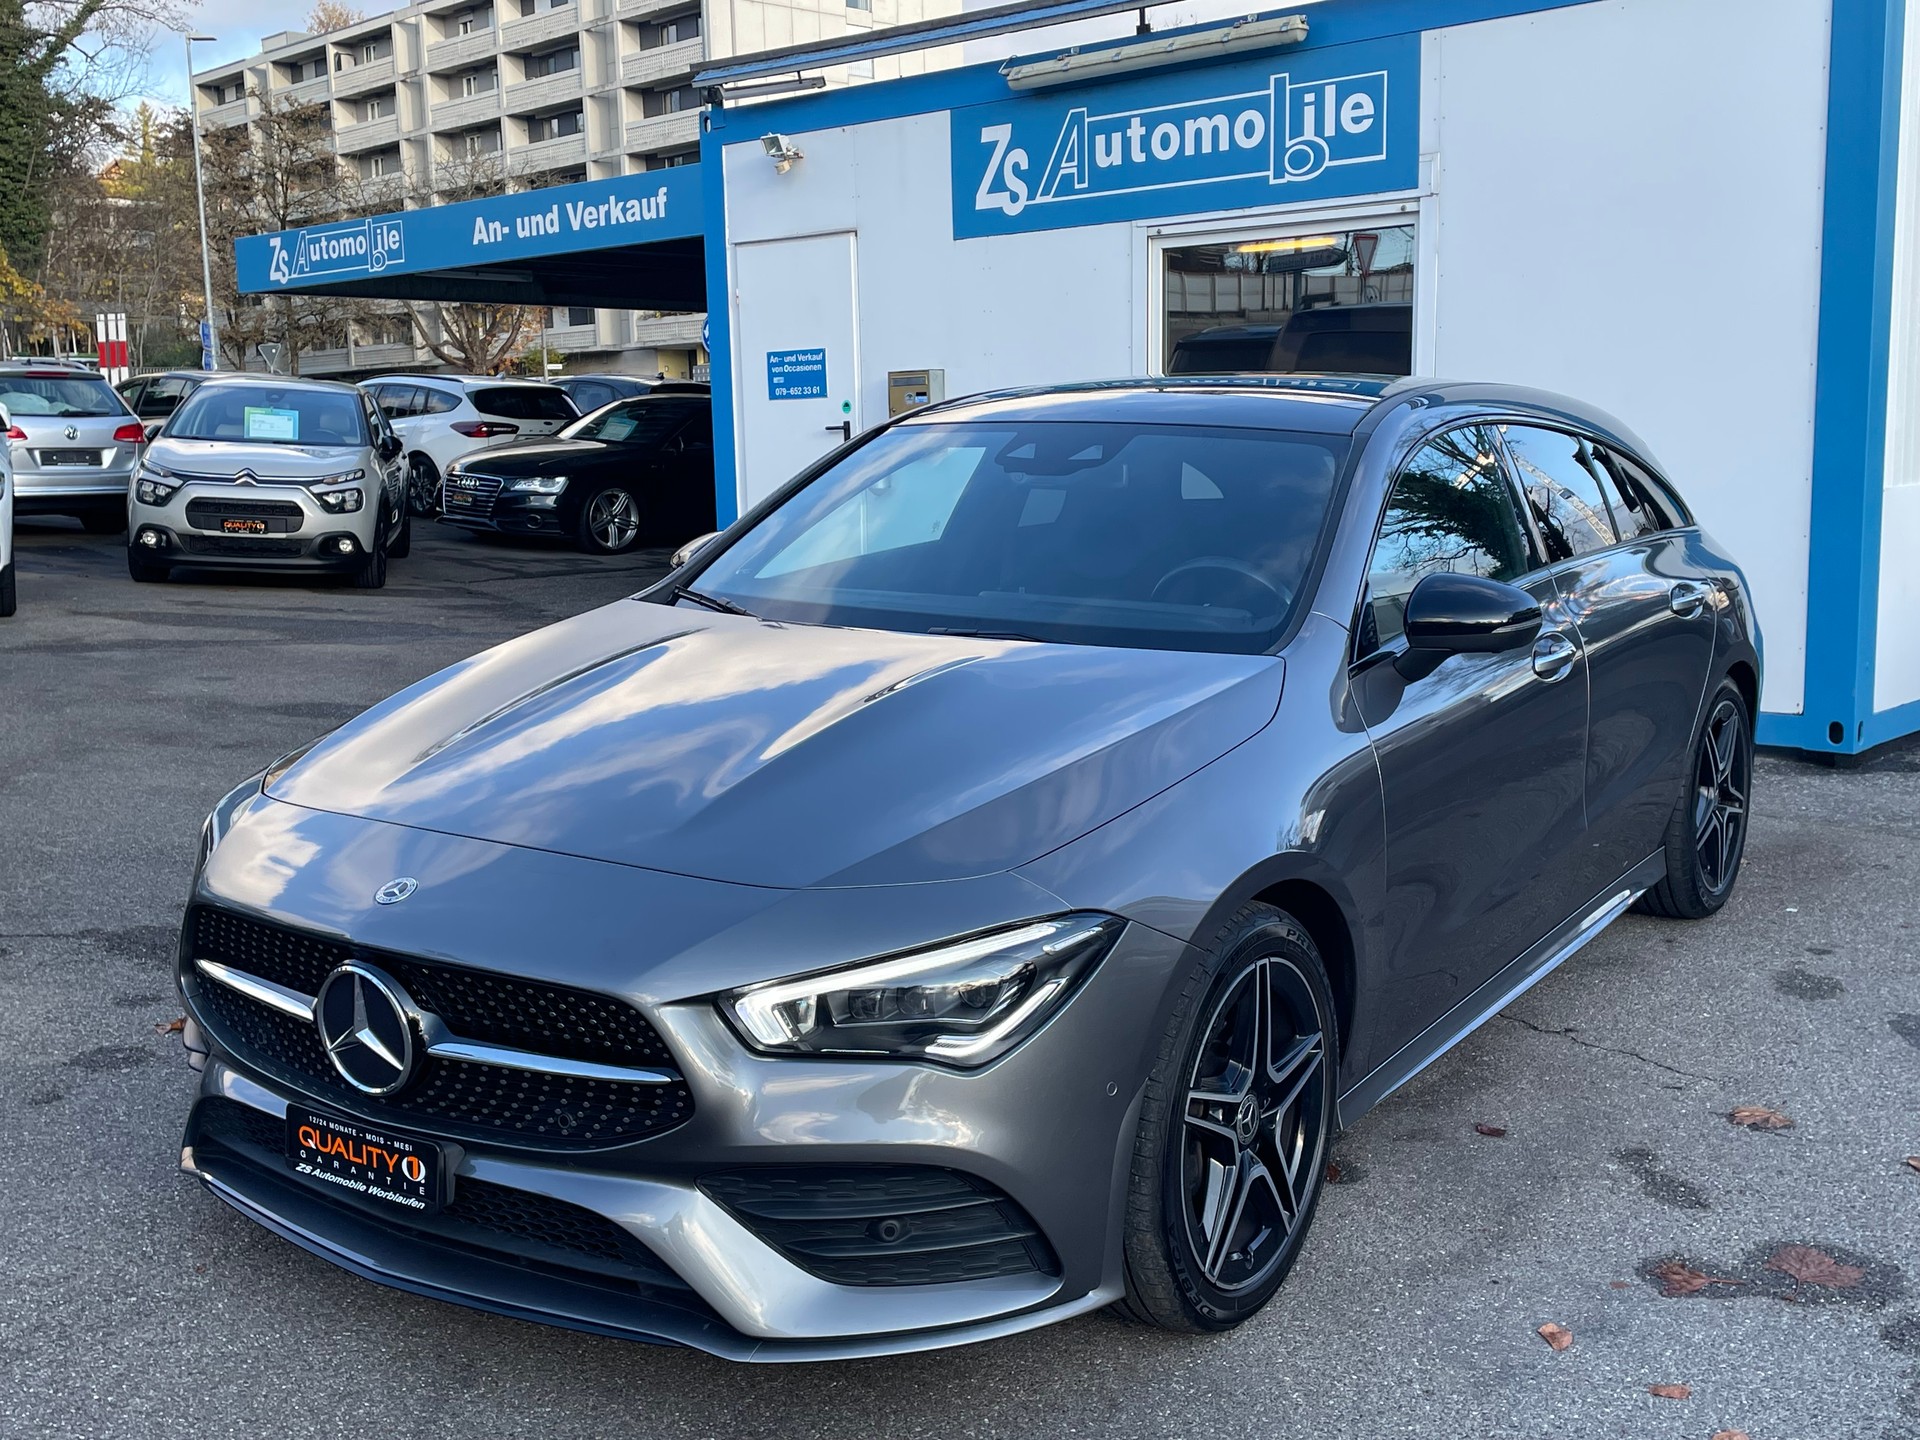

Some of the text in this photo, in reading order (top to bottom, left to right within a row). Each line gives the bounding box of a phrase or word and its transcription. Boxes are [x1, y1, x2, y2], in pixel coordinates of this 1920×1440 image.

[975, 73, 1376, 217] Zs Automobile
[472, 186, 668, 246] An- und Verkauf
[269, 219, 401, 285] Zs Automobile
[769, 352, 823, 363] An- und Verkauf
[784, 364, 822, 372] Occasionen
[803, 386, 812, 395] 33
[812, 386, 820, 394] 61
[298, 1125, 399, 1174] QUALITY
[308, 1114, 328, 1128] 12/24
[329, 1120, 358, 1137] MONATE
[365, 1131, 385, 1145] MOIS
[393, 1139, 413, 1152] MESI
[295, 1162, 426, 1210] ZS Automobile Worblaufen
[300, 1149, 426, 1196] GARANTIE
